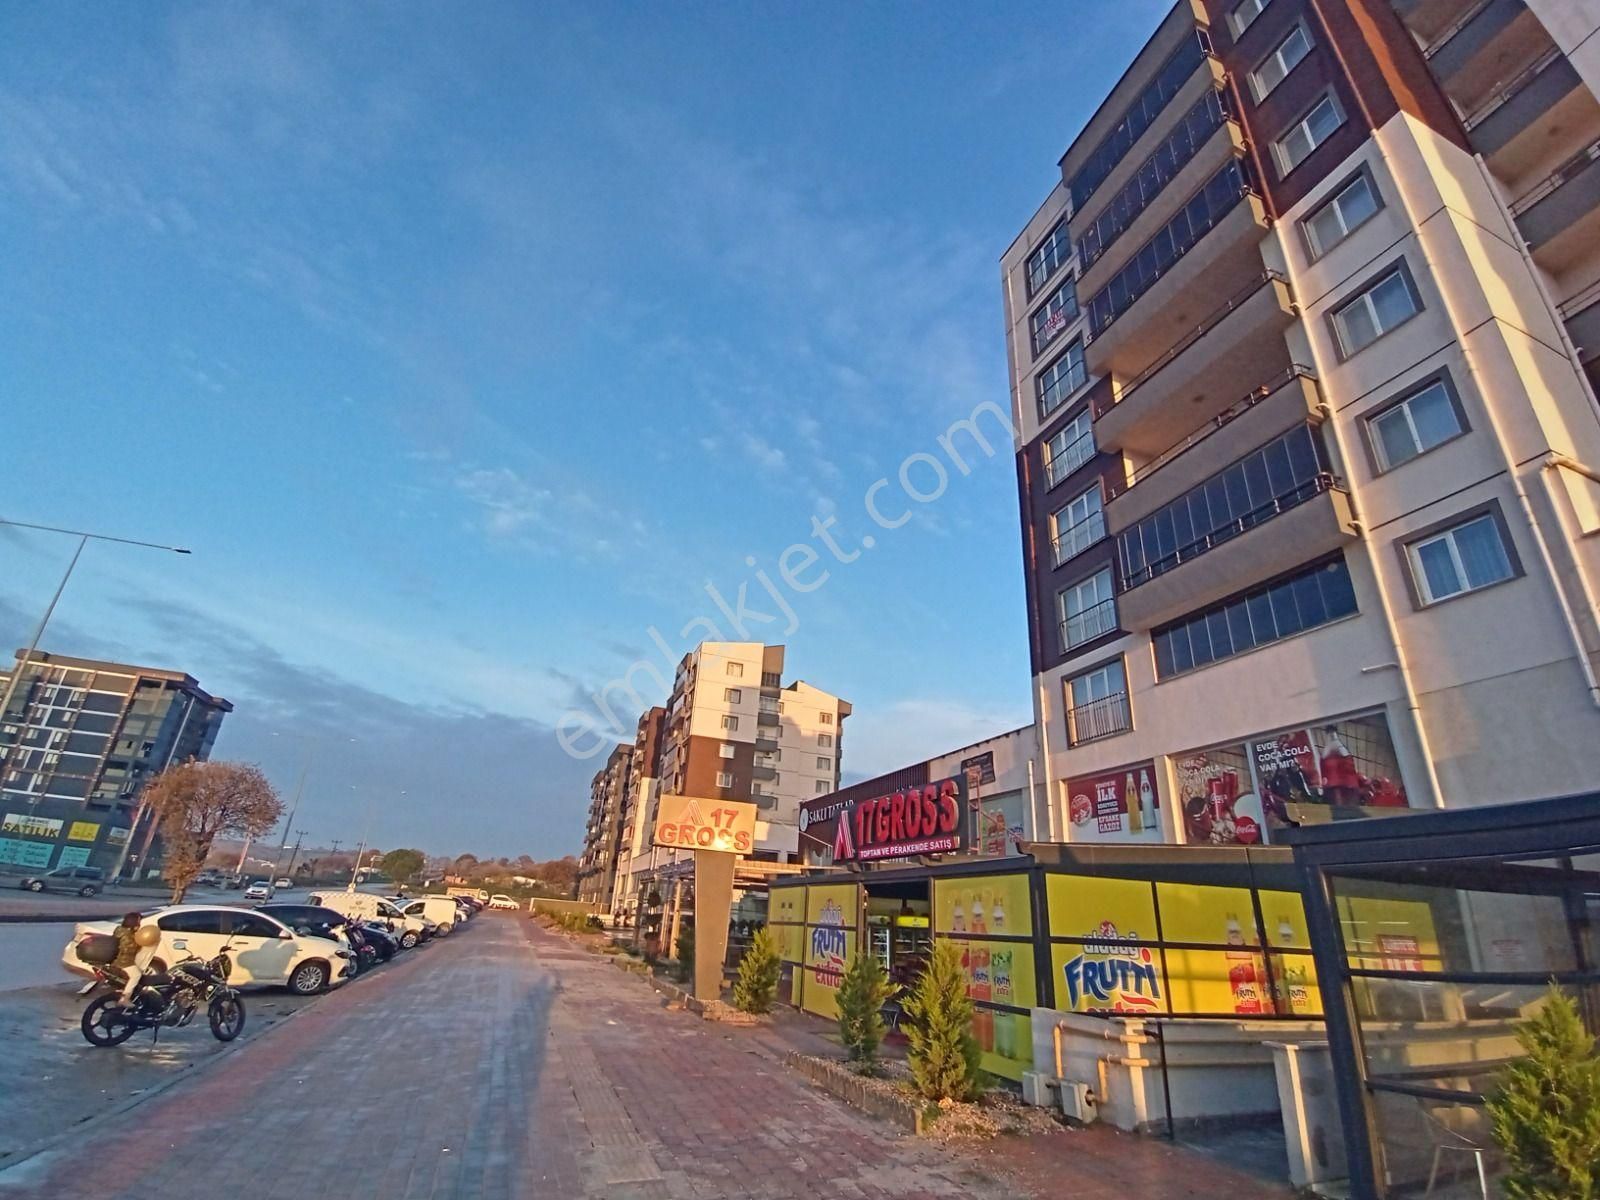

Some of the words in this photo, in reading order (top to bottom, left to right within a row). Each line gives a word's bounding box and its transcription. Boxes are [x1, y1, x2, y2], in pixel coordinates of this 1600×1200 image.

[1256, 740, 1279, 752] EVDE
[1257, 745, 1311, 763] COCA-COLA
[1259, 762, 1278, 773] VAR
[710, 808, 739, 829] 17
[809, 807, 827, 824] SAKLI
[3, 821, 59, 839] SATILIK
[859, 849, 881, 858] TOPTAN
[881, 846, 890, 856] VE
[890, 842, 929, 854] PERAKENDE
[929, 839, 952, 850] SATIŞ
